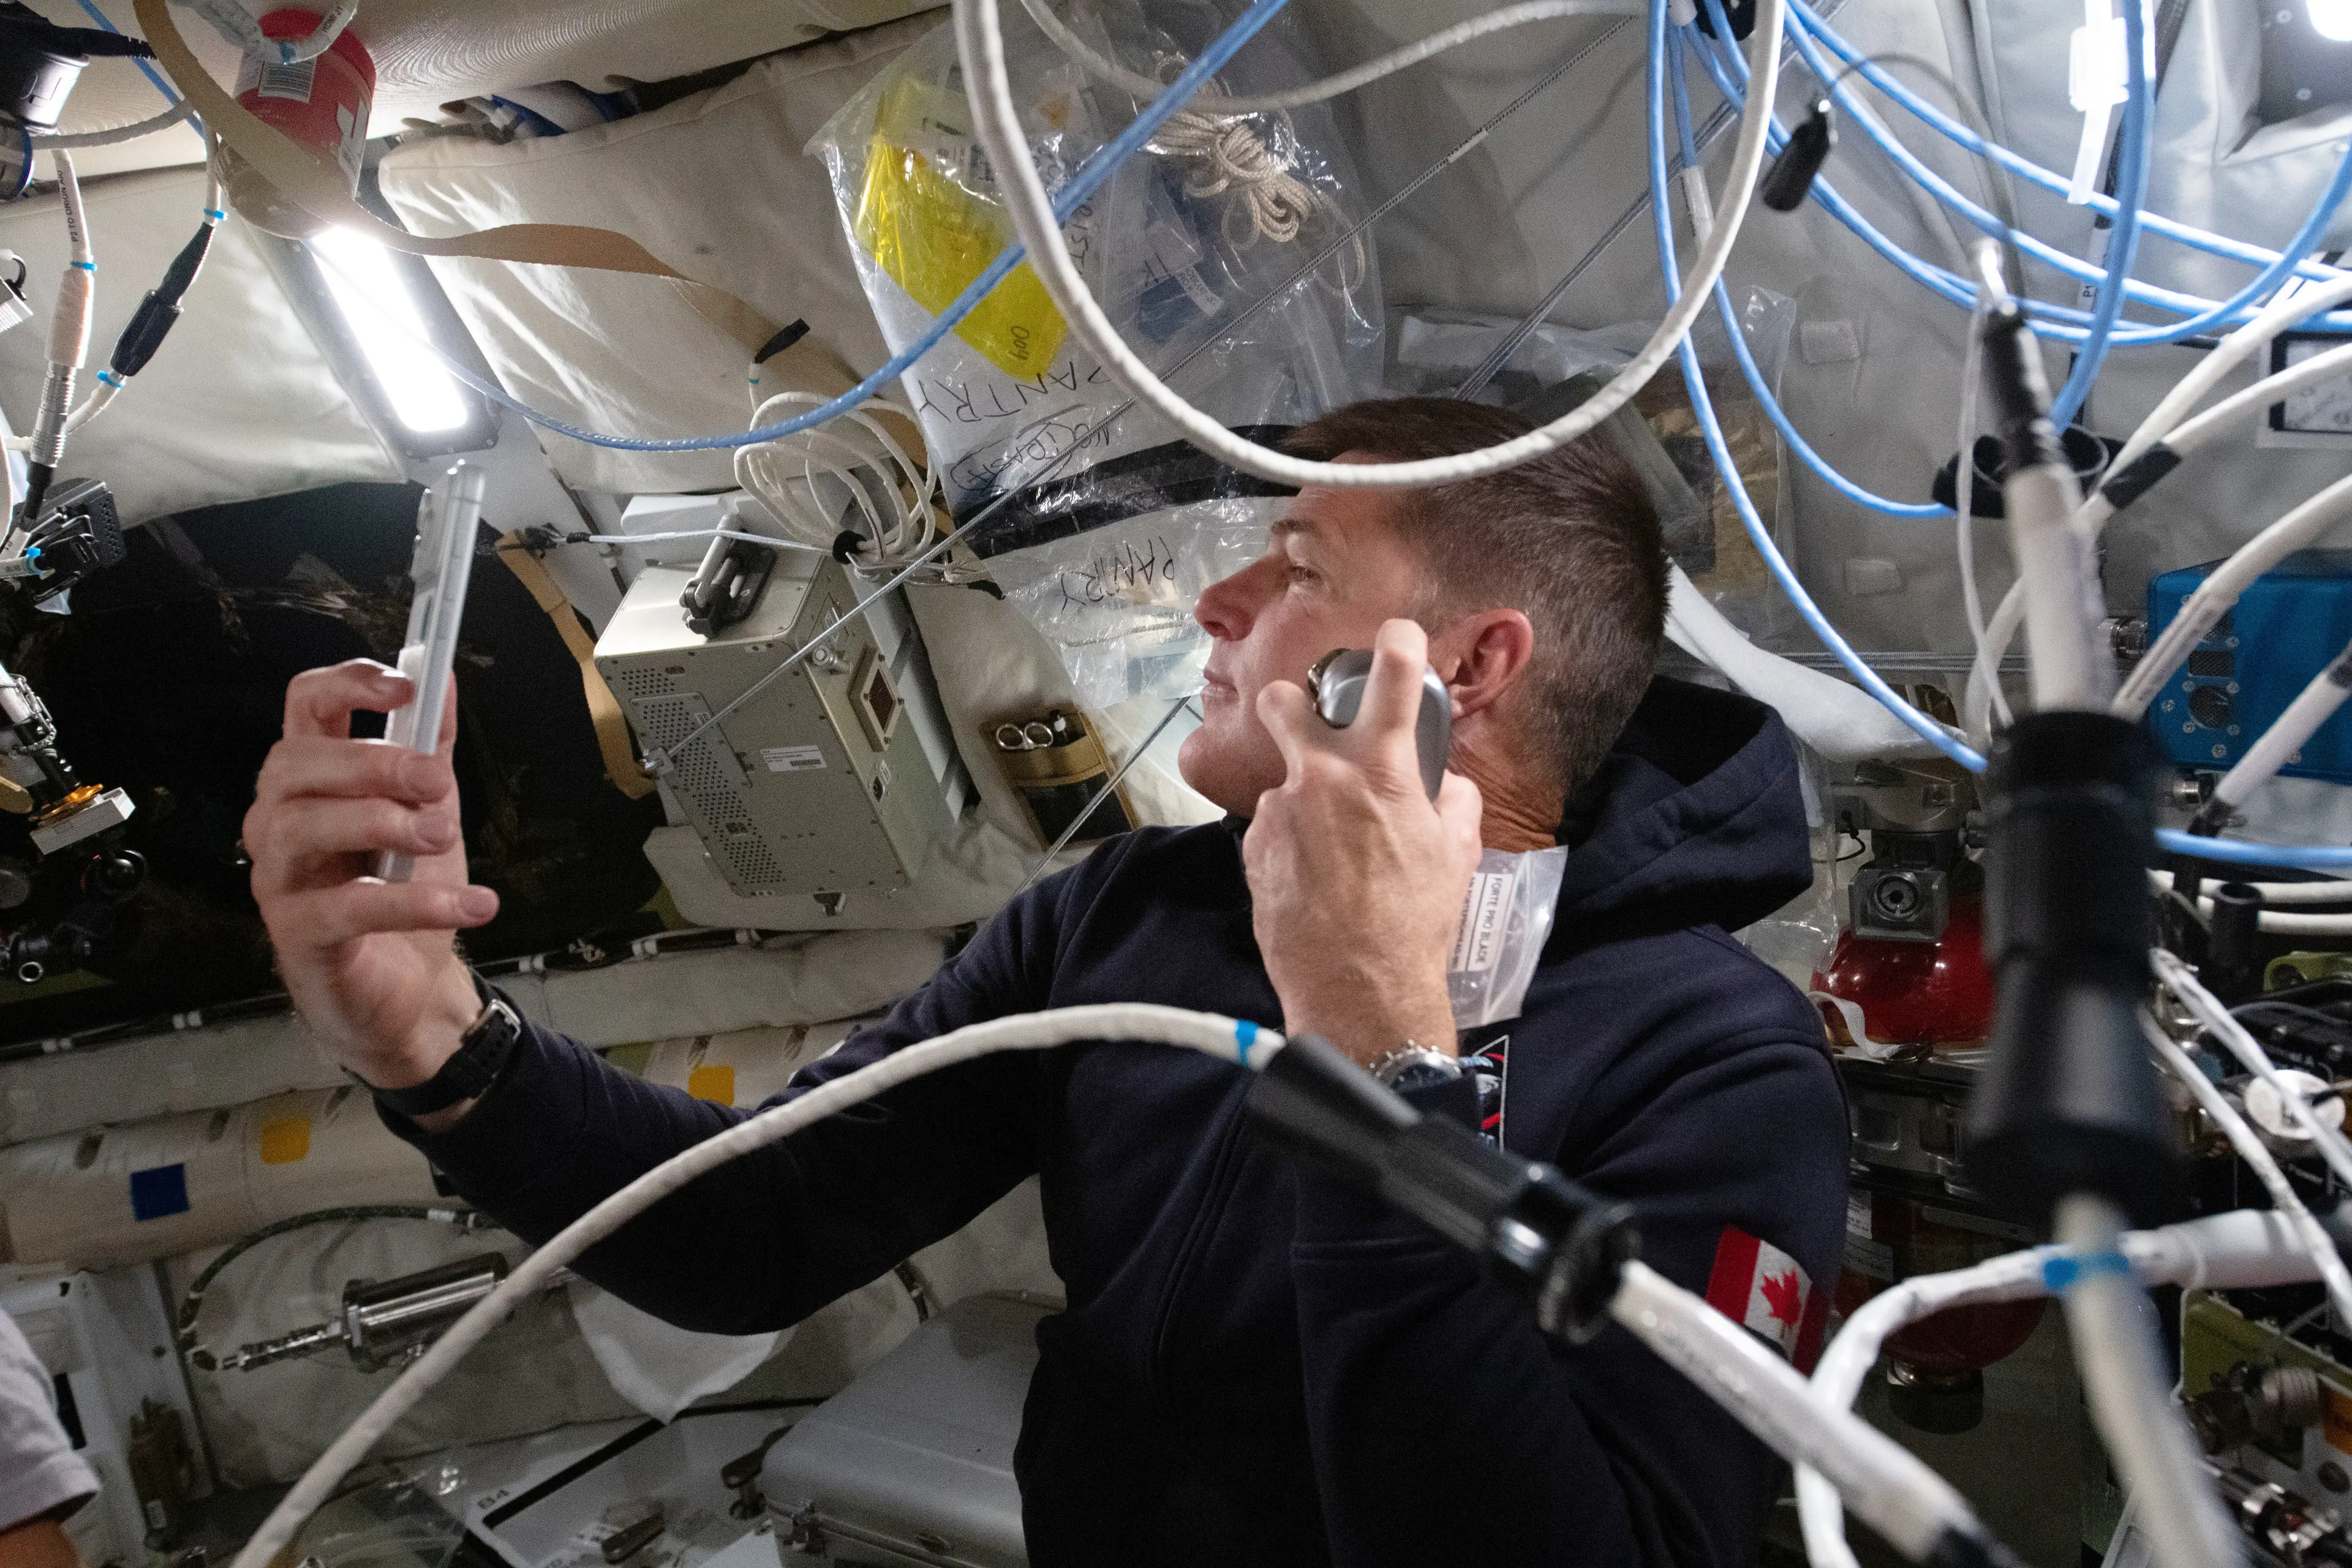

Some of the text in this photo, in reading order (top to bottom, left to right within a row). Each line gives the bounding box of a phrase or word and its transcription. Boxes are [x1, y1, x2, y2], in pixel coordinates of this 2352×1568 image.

[61, 187, 72, 216] ORION
[67, 217, 75, 228] TO
[70, 232, 78, 242] P2
[1061, 536, 1175, 614] PANTRY
[1475, 876, 1502, 964] FORTE PRO BLADE
